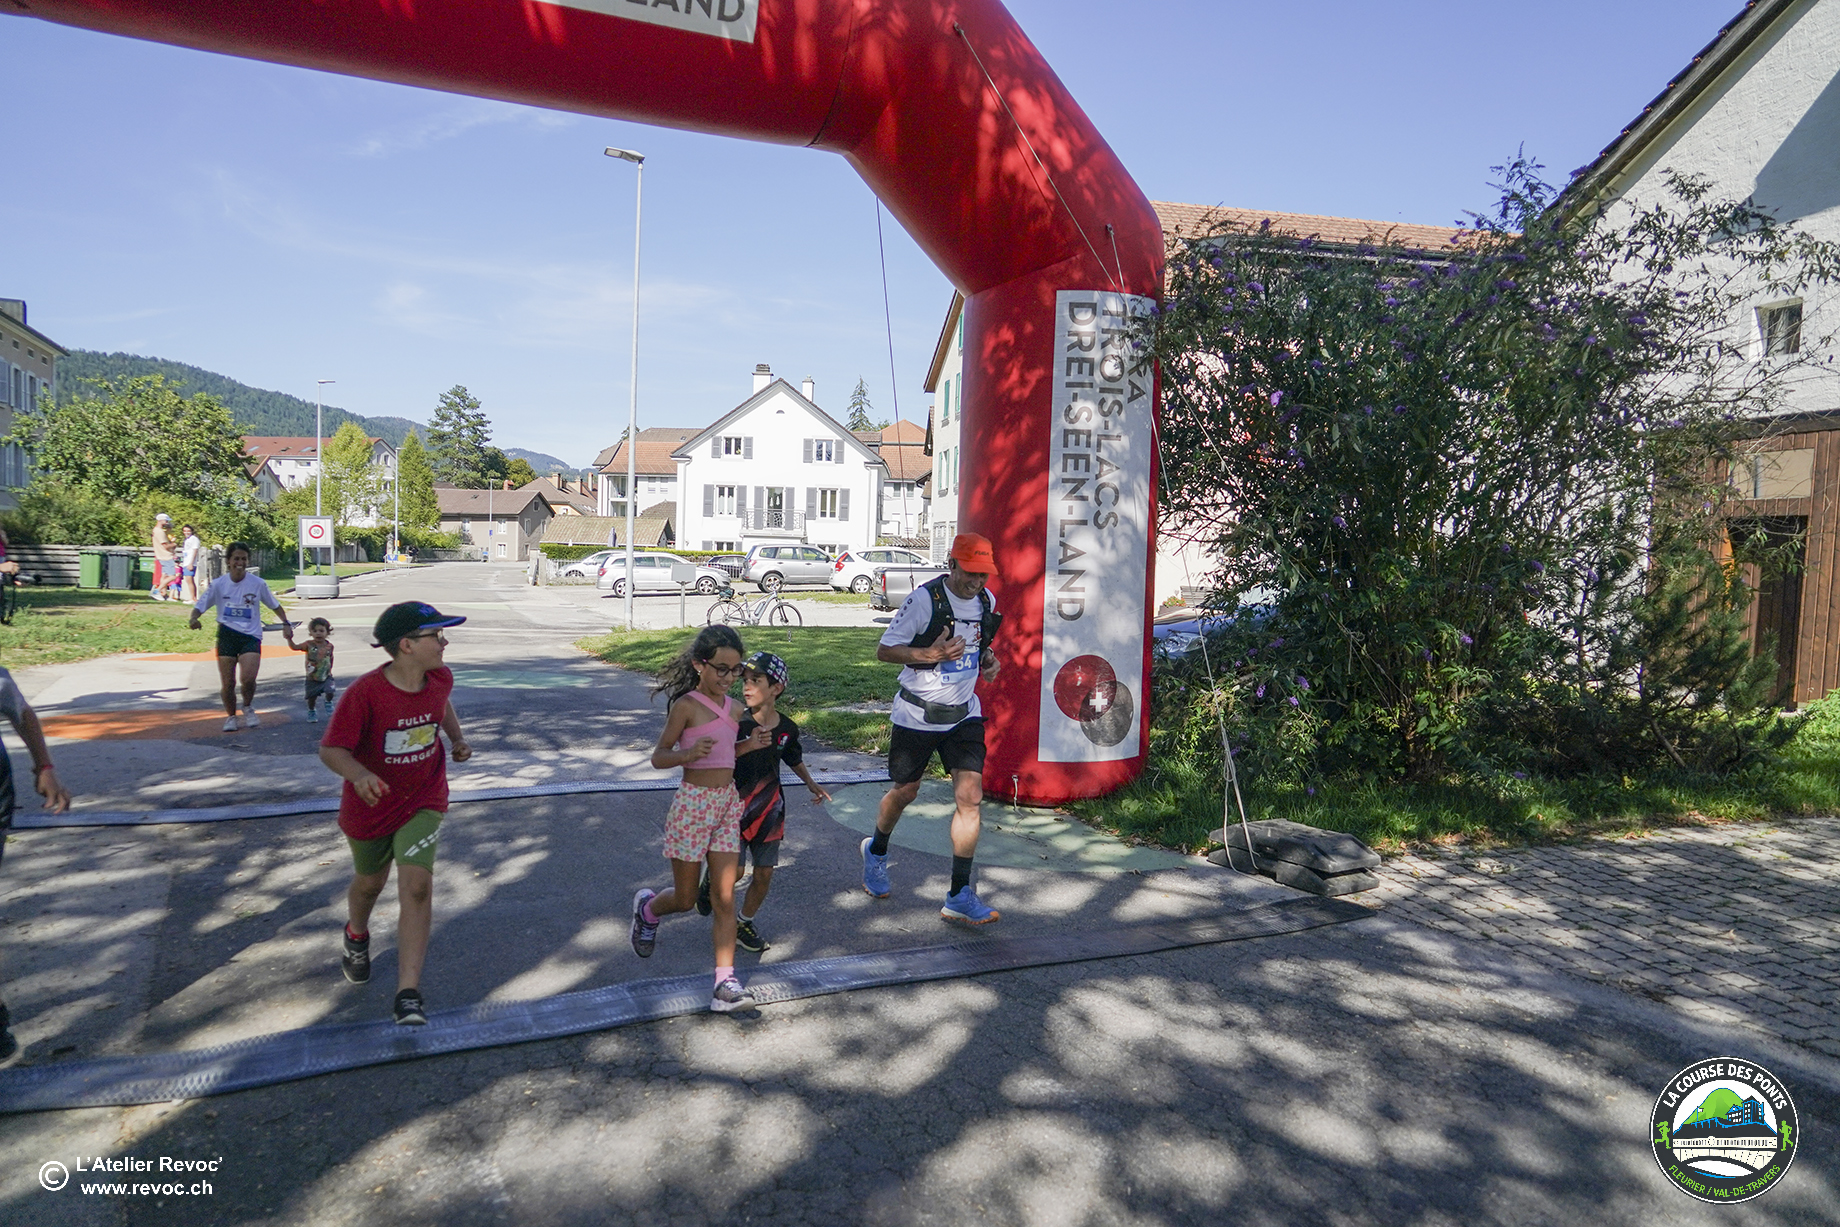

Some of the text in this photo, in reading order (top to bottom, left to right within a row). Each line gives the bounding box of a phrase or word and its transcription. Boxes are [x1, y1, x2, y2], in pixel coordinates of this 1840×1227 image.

[1093, 303, 1127, 530] TROIS-LACS
[1056, 302, 1097, 621] DREI-SEEN-LAND
[231, 609, 243, 617] 53
[955, 654, 972, 671] 54
[397, 713, 432, 727] FULLY
